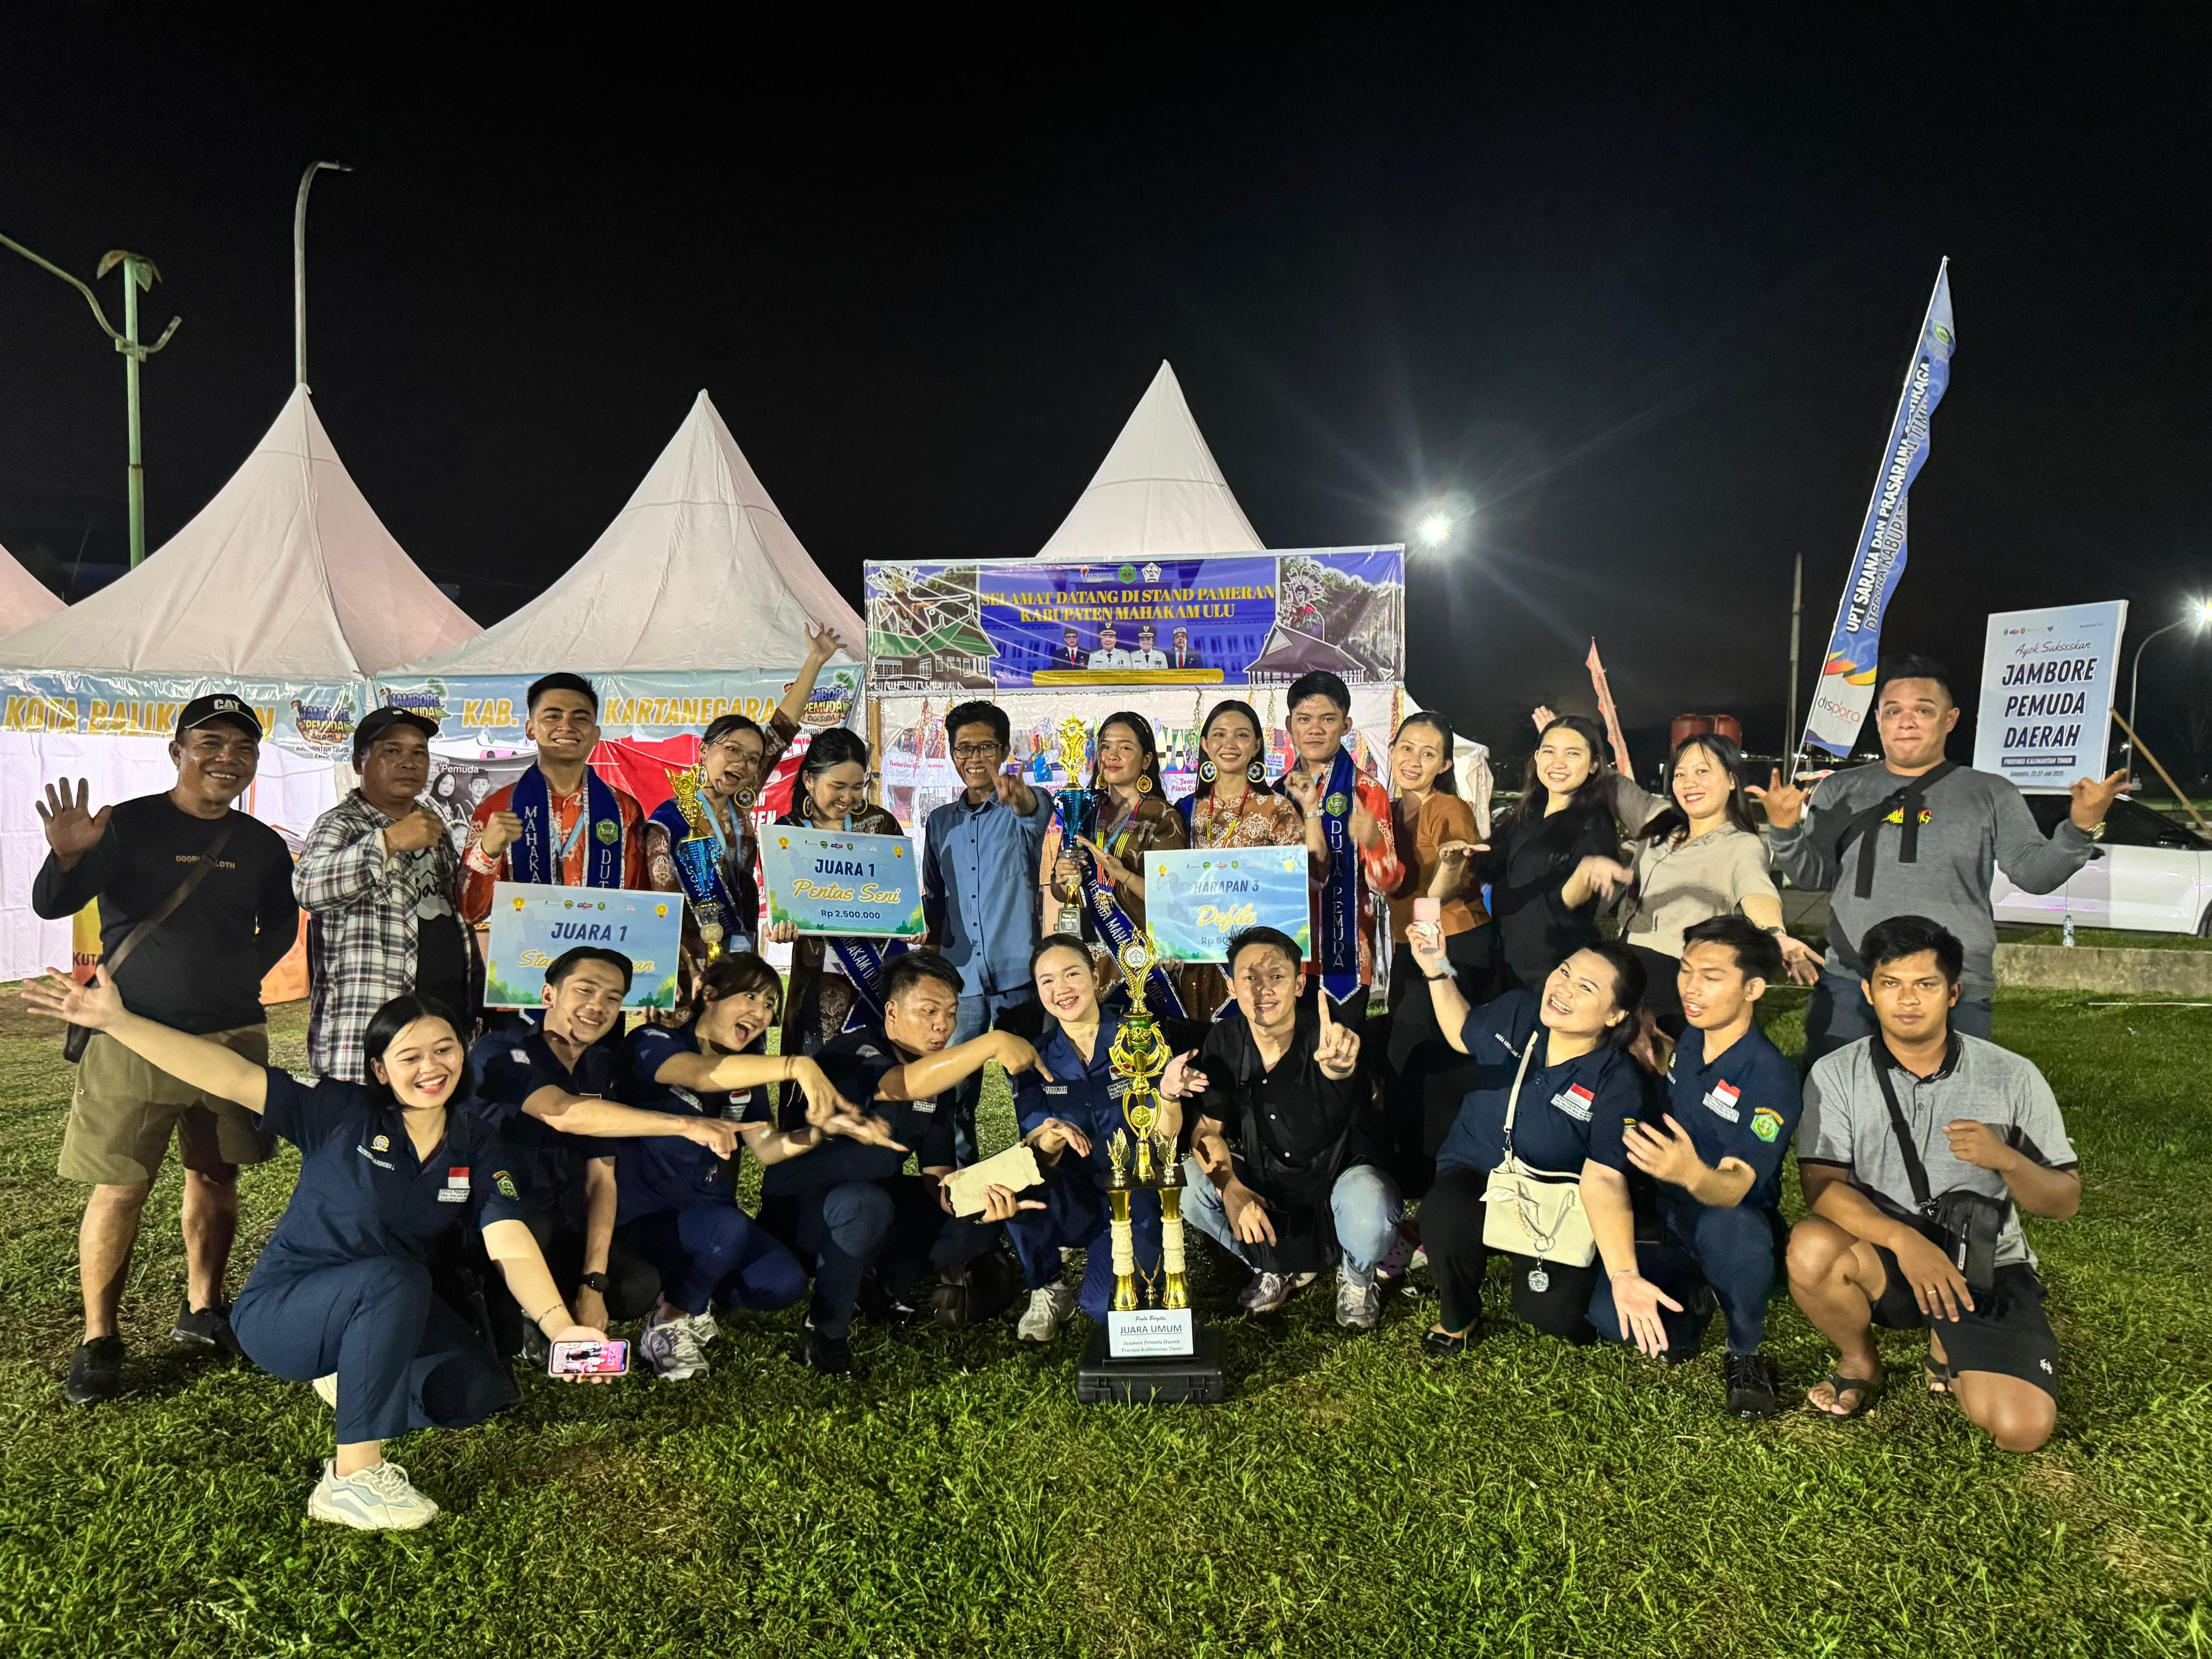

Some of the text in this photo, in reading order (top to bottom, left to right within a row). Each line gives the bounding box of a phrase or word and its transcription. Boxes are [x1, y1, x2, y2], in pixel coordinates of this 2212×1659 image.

[1879, 439, 1910, 518] PRASARANA
[1871, 520, 1887, 549] DAN
[1854, 552, 1880, 604] SARANA
[981, 585, 1276, 606] SELAMAT DATANG DI STAND PAMERAN
[1020, 603, 1235, 622] KABUPATEN MAHAKAM ULU
[1846, 604, 1865, 633] UPT
[2015, 639, 2091, 658] Ayok Sukseskan
[2002, 658, 2098, 686] JAMBORE
[214, 699, 241, 711] CAT
[391, 693, 440, 707] JAMBORE
[2004, 692, 2085, 717] PEMUDA
[3, 696, 276, 740] KOTA BALIKN
[462, 698, 519, 728] KAB.
[2003, 724, 2081, 749] DAERAH
[815, 858, 876, 877] JUARA 1
[793, 879, 901, 904] Pentas Seni
[1194, 879, 1260, 895] HARAPAN 3
[1331, 820, 1345, 968] DUTA PEMUDA
[820, 910, 880, 920] Rp 2.500.000
[1196, 903, 1258, 928] Defile
[551, 922, 628, 941] JUARA 1
[1201, 937, 1214, 946] Rp
[1120, 1325, 1183, 1334] JUARA UMUM
